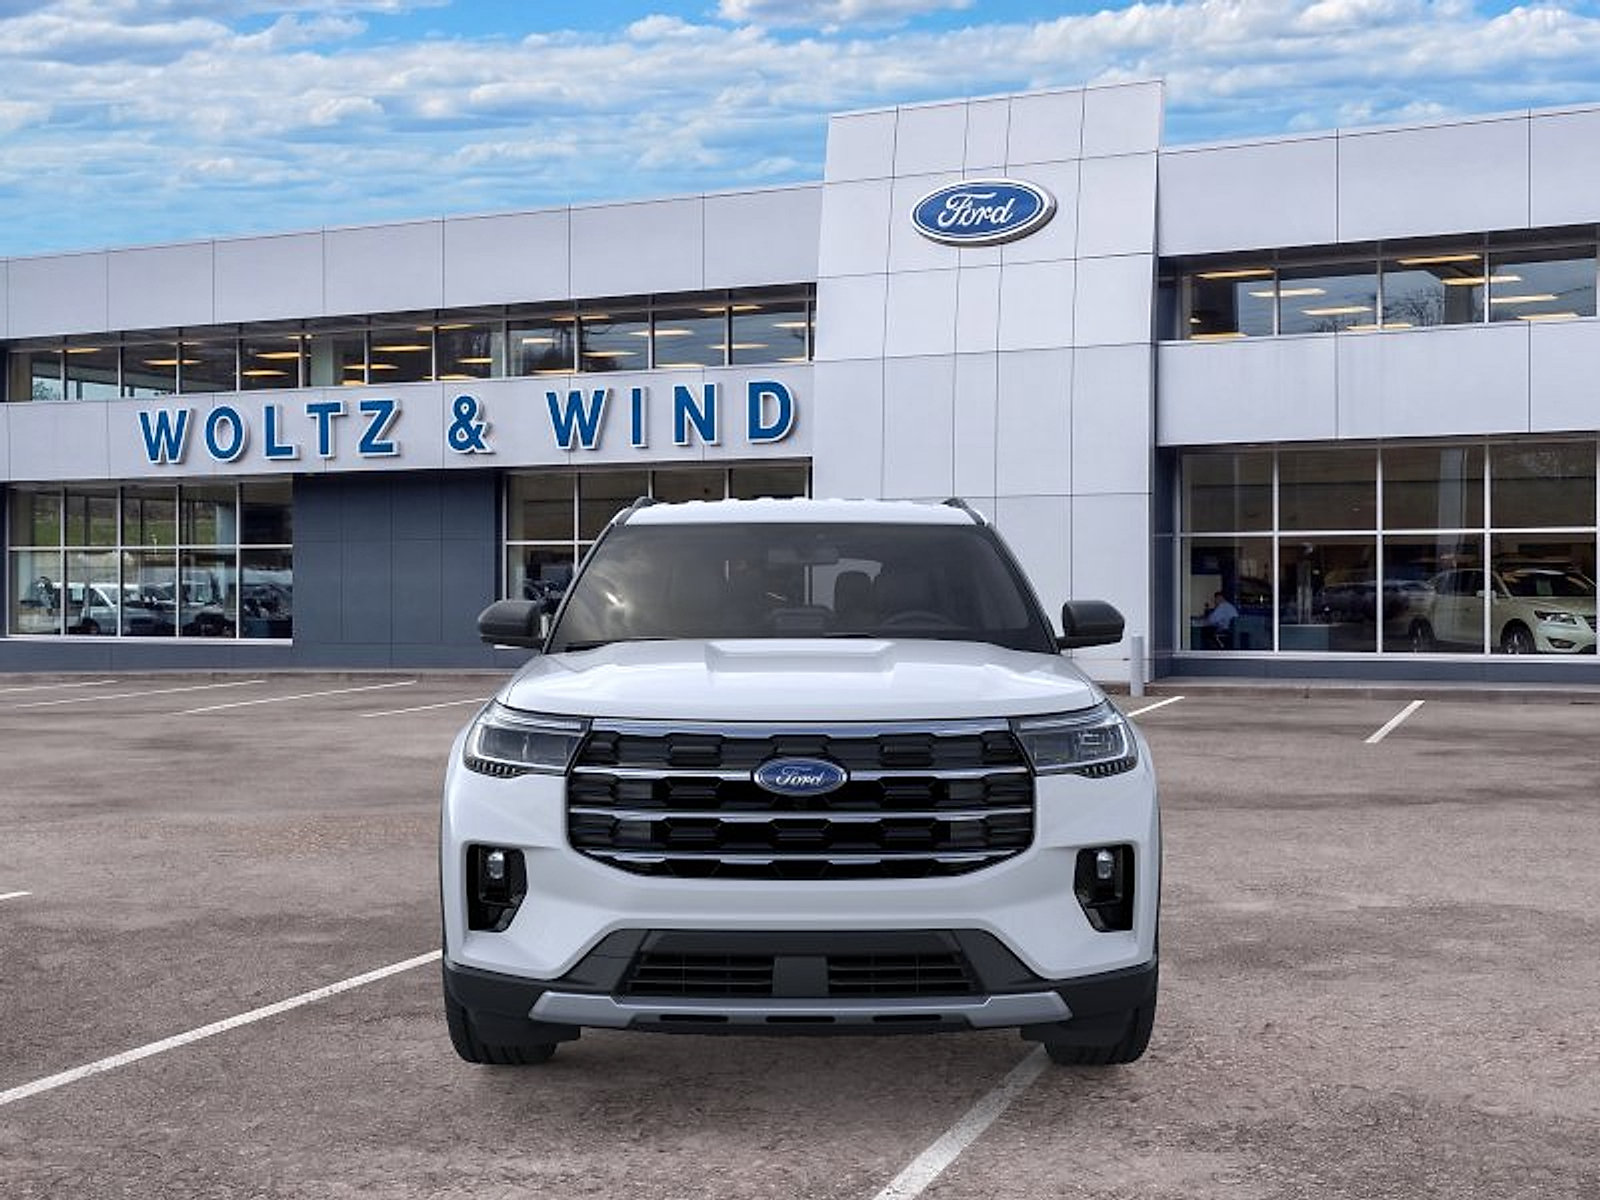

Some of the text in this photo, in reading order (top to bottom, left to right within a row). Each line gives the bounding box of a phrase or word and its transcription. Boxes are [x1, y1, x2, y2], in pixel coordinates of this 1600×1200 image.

[937, 192, 1015, 227] Ford
[138, 379, 796, 464] WOLTZ & WIND
[775, 766, 825, 786] Ford
